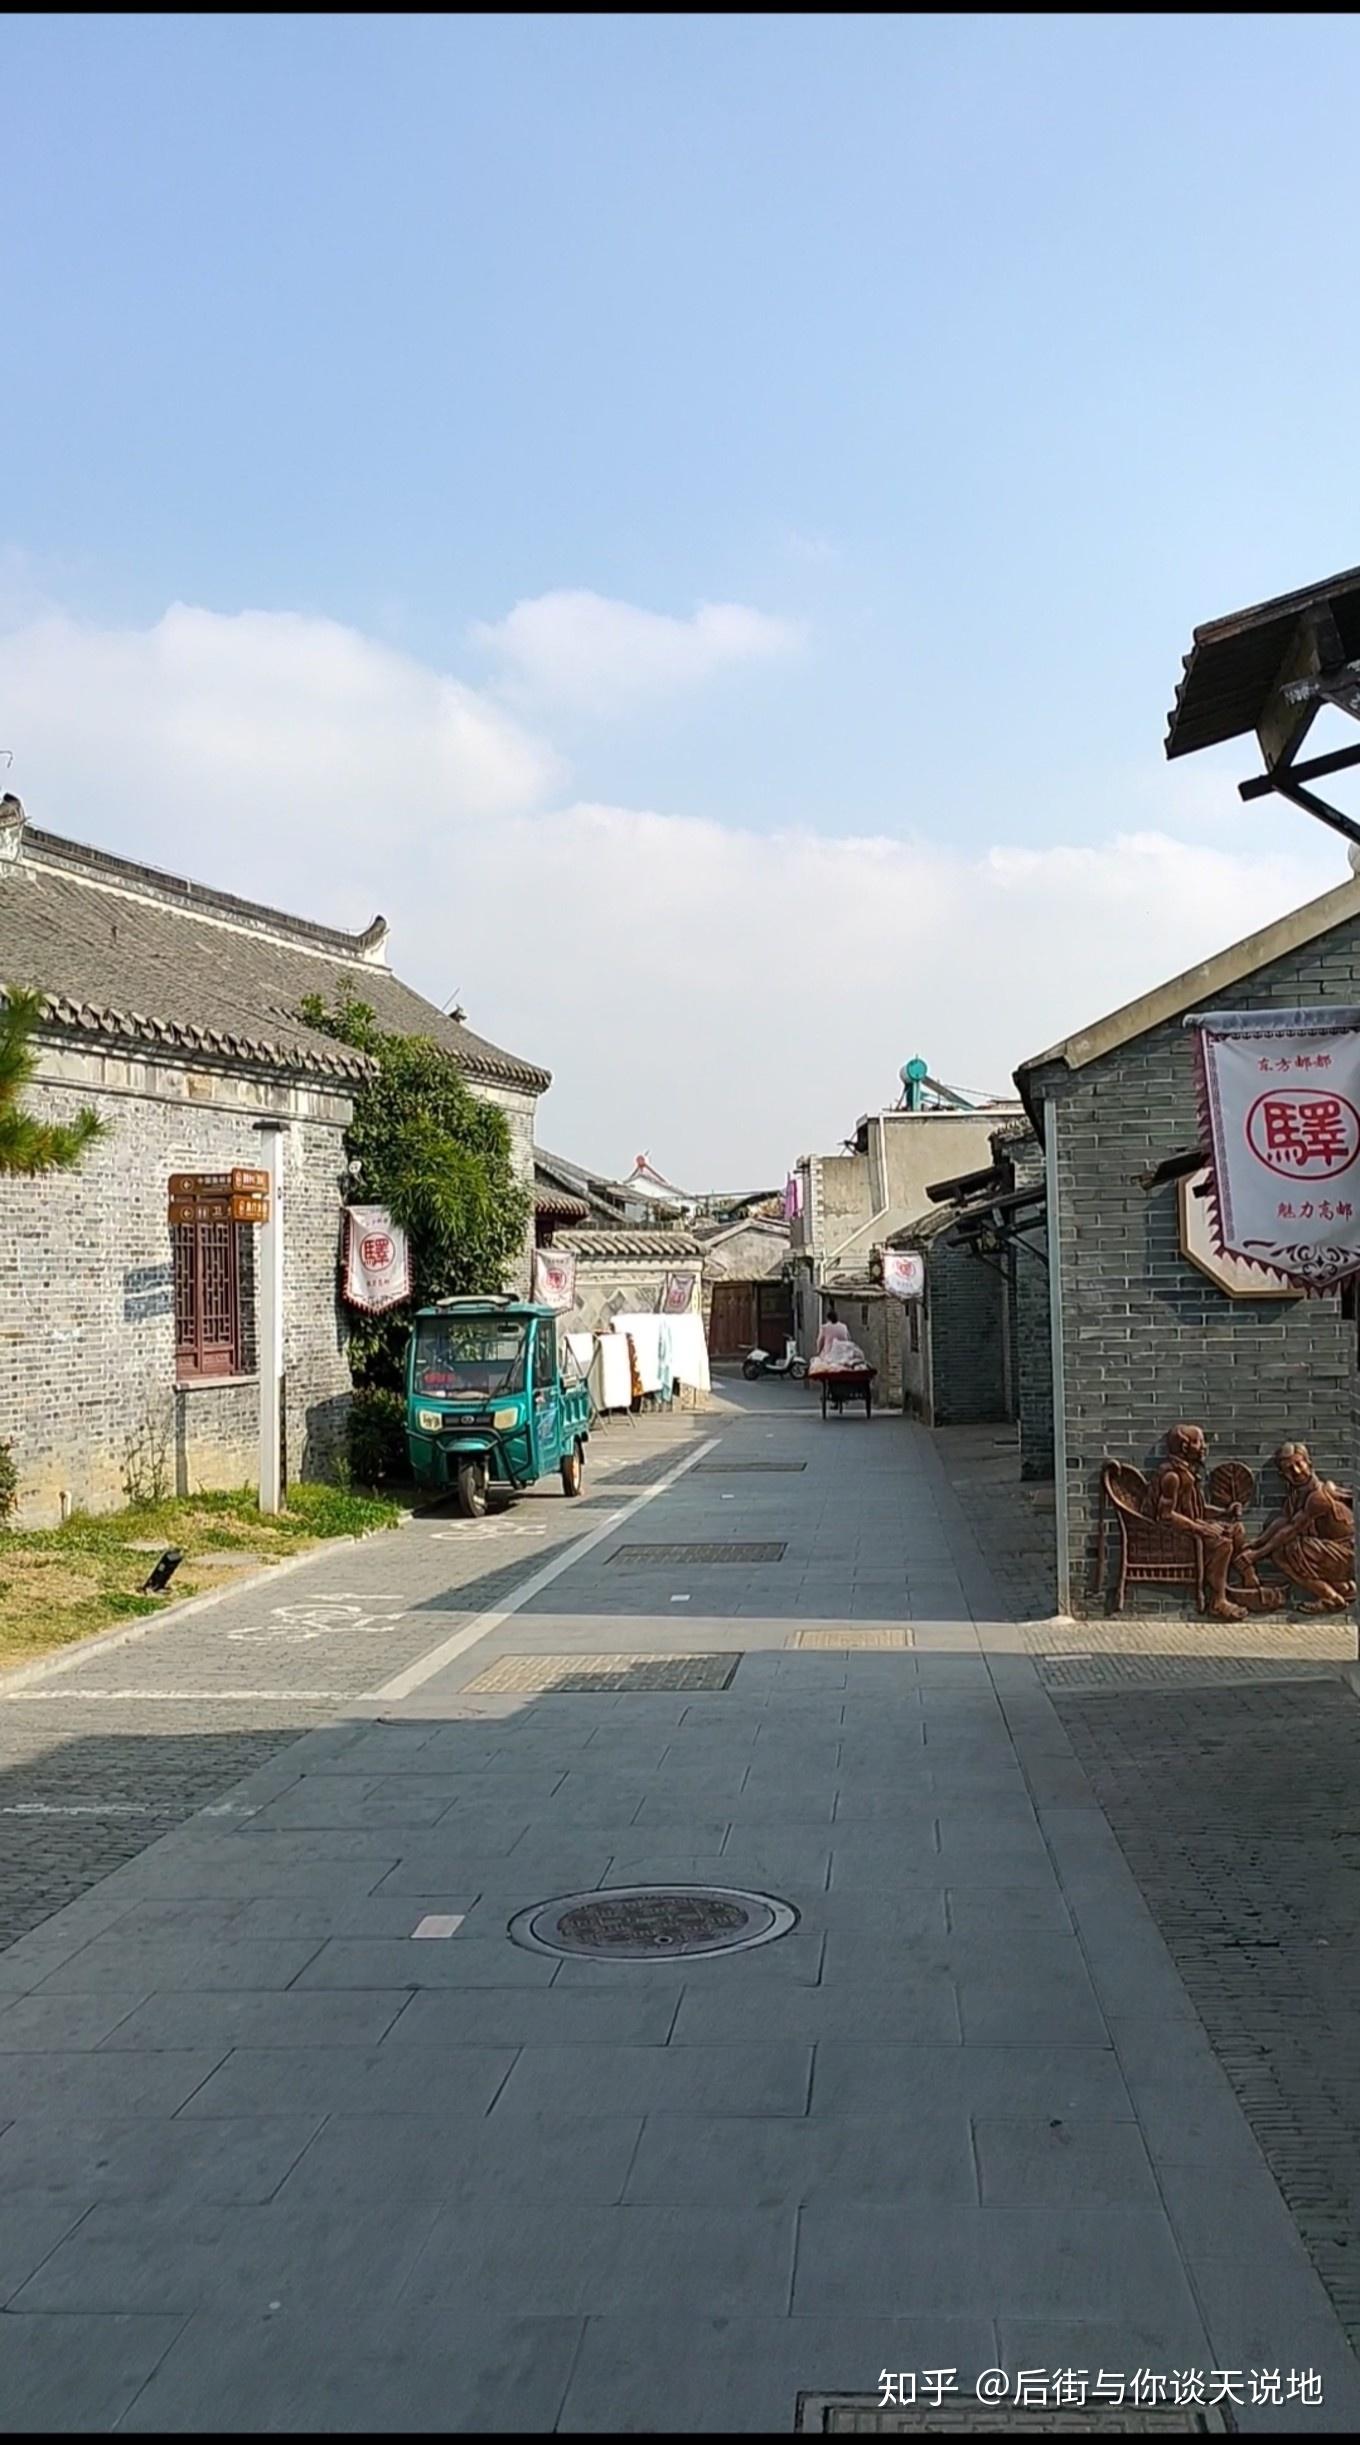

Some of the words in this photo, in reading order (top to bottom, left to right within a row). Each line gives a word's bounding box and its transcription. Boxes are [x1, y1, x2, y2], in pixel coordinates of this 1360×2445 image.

[1258, 1055, 1332, 1072] 东方邮都
[1263, 1100, 1349, 1166] 驛
[1277, 1201, 1353, 1221] 魅力高邮
